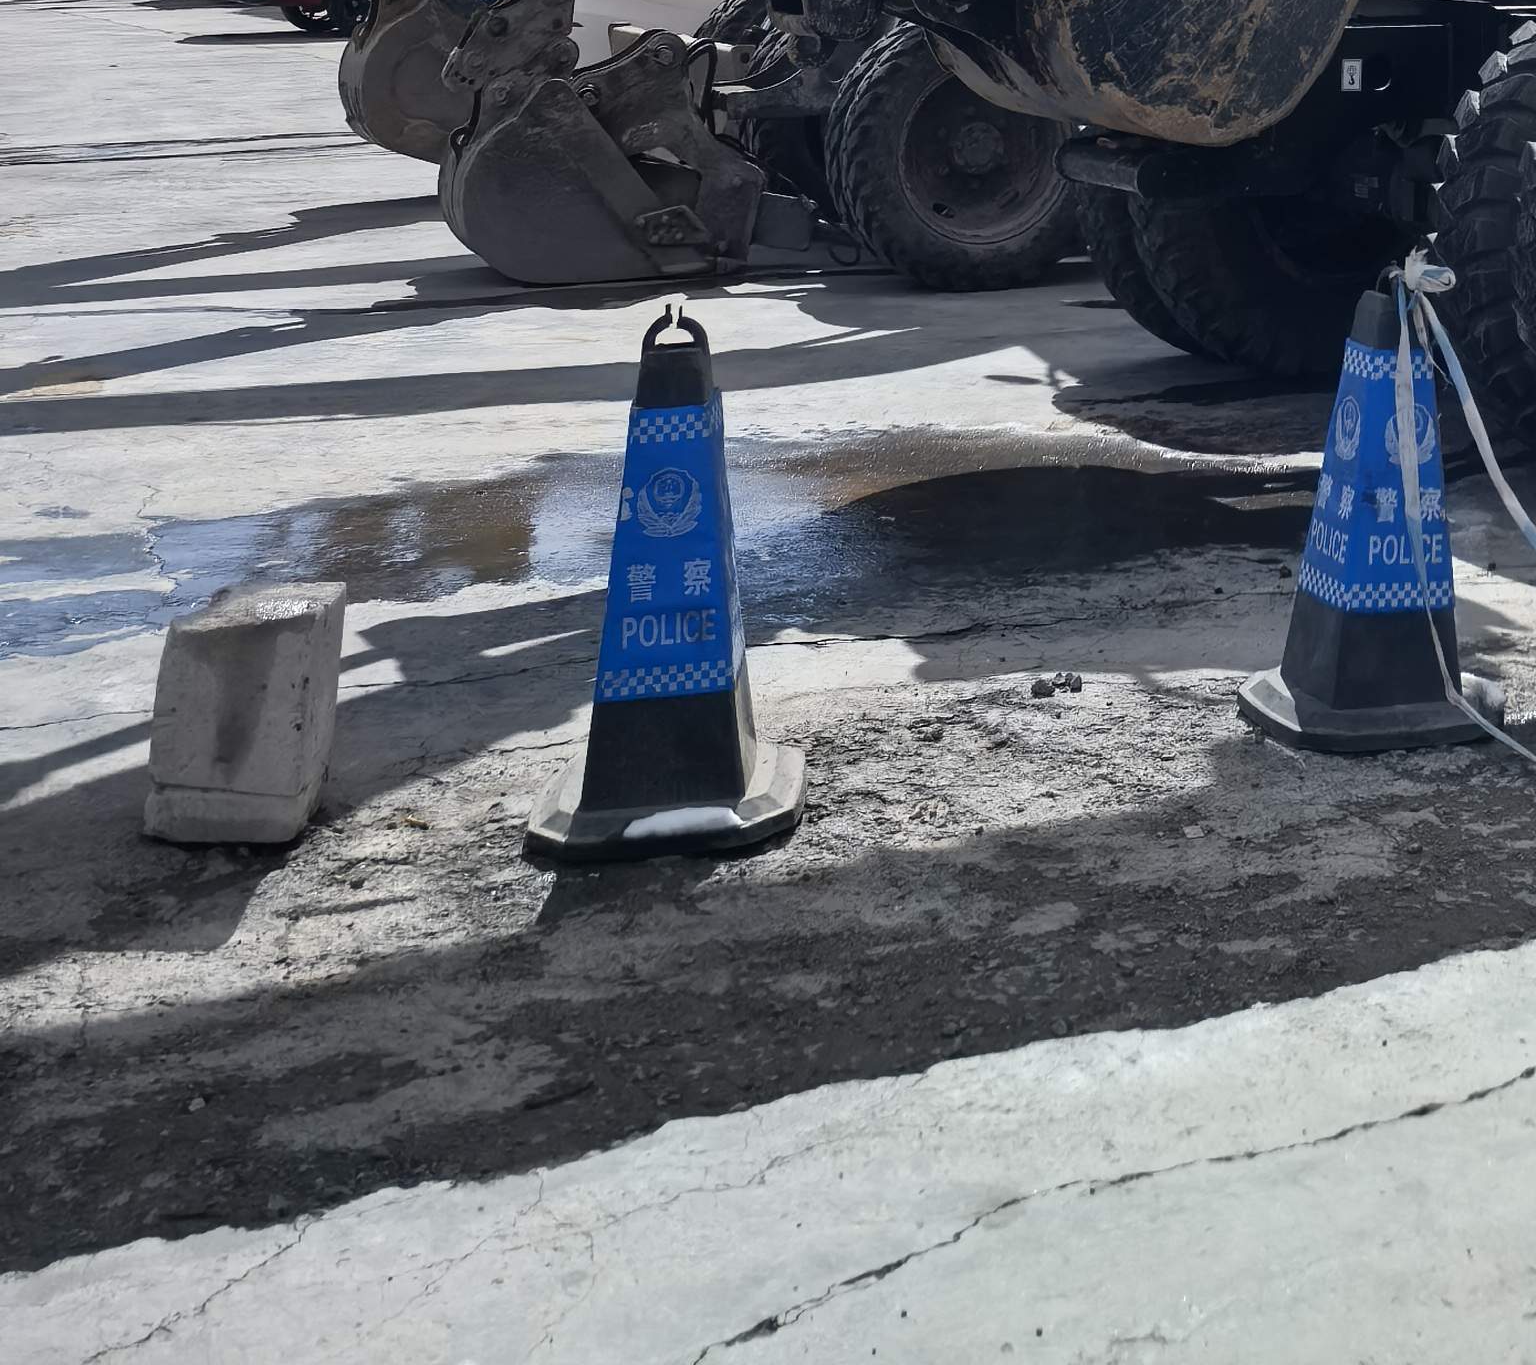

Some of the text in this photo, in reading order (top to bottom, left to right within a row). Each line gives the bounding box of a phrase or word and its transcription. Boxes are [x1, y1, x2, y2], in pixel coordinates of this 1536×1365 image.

[1374, 486, 1442, 523] 警察
[1310, 517, 1348, 565] POLICE
[1369, 533, 1443, 565] POLCE
[626, 558, 712, 603] 警察
[622, 609, 716, 650] POLICE
